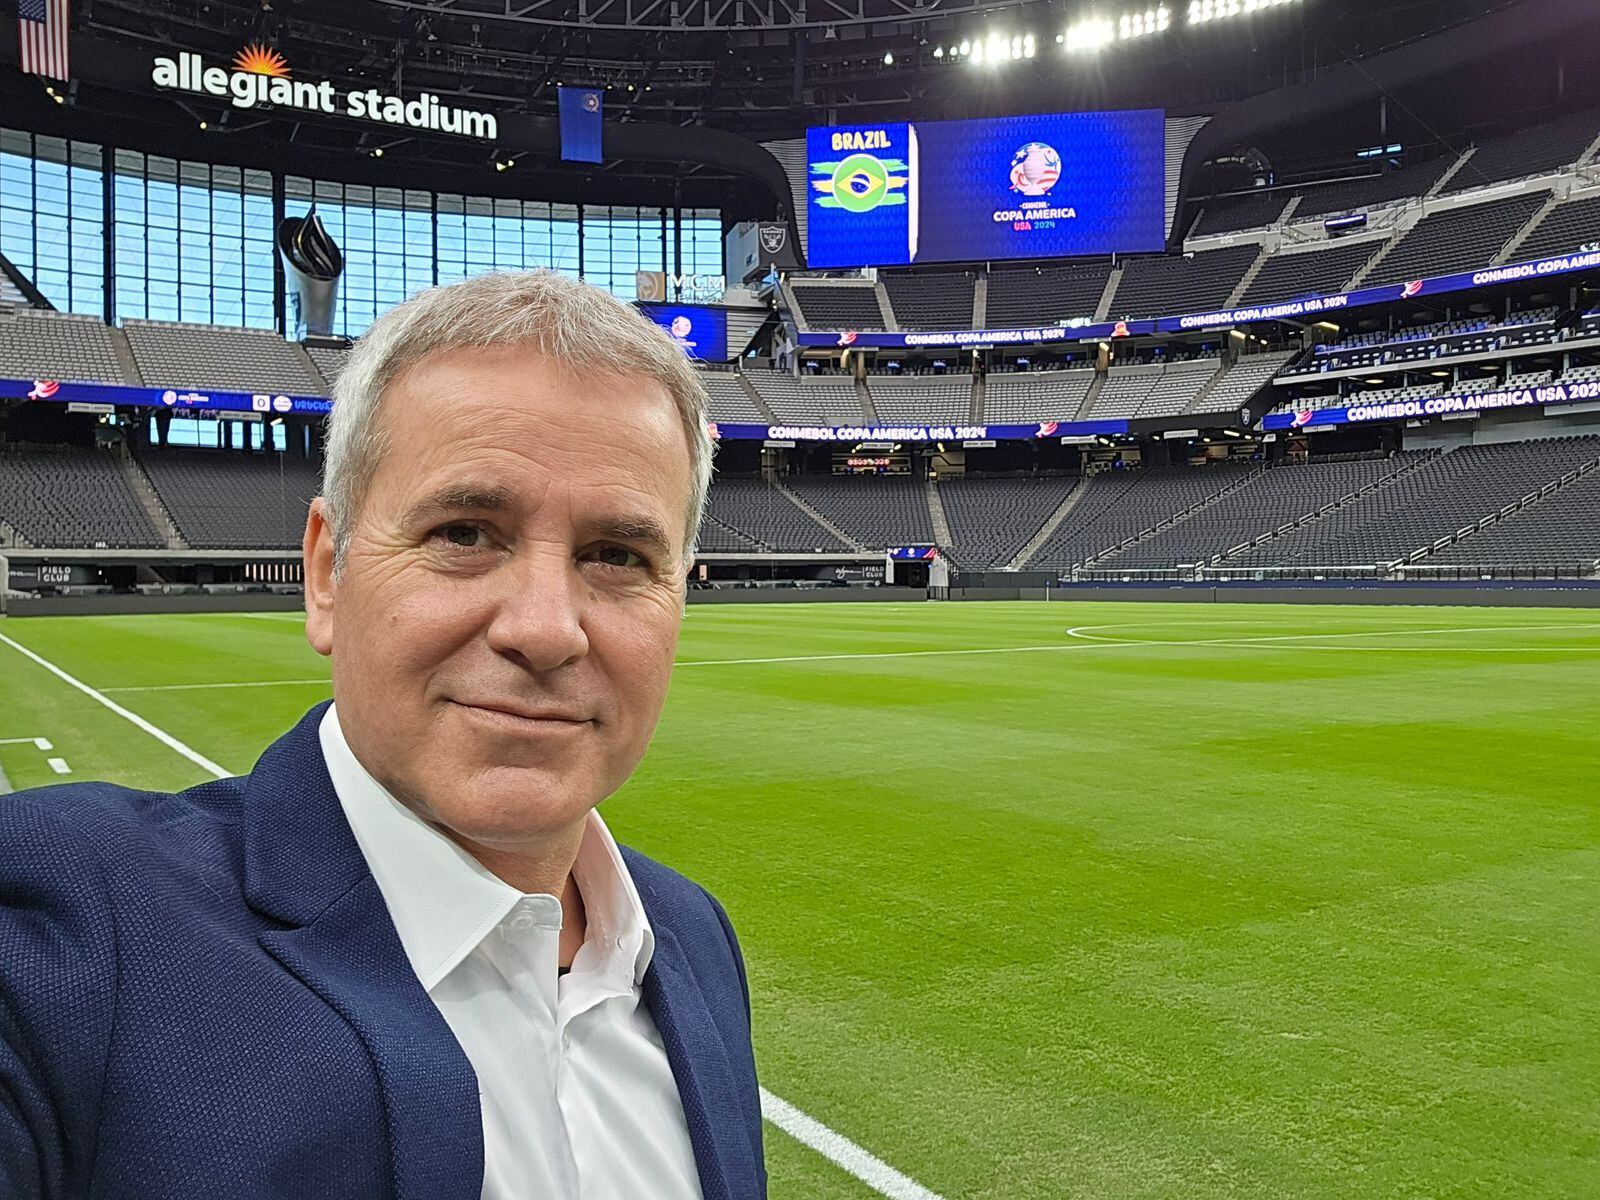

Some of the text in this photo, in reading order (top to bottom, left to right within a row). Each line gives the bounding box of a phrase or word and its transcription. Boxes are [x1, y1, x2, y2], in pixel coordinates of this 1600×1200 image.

[152, 52, 498, 140] allegiant stadium
[831, 130, 892, 151] BRAZIL
[993, 208, 1076, 221] COPA AMERICA
[1014, 221, 1055, 230] USA 2024
[1473, 264, 1537, 285] CONMEBOL
[1536, 258, 1571, 275] COPA
[669, 272, 726, 293] MGM
[1179, 295, 1348, 328] CONMEBOL COPA AMERICA USA 2024
[905, 328, 1066, 345] CONMEBOL COPA AMERICA USA 2024
[1347, 400, 1424, 422] CONMEBOL
[1424, 397, 1465, 415] COPA
[1464, 390, 1534, 410] AMERICA
[1537, 386, 1568, 402] USA
[768, 426, 988, 440] CONMEBOL COPA AMERICA USA 2024
[42, 565, 72, 574] FIELD
[43, 573, 70, 582] CLUB
